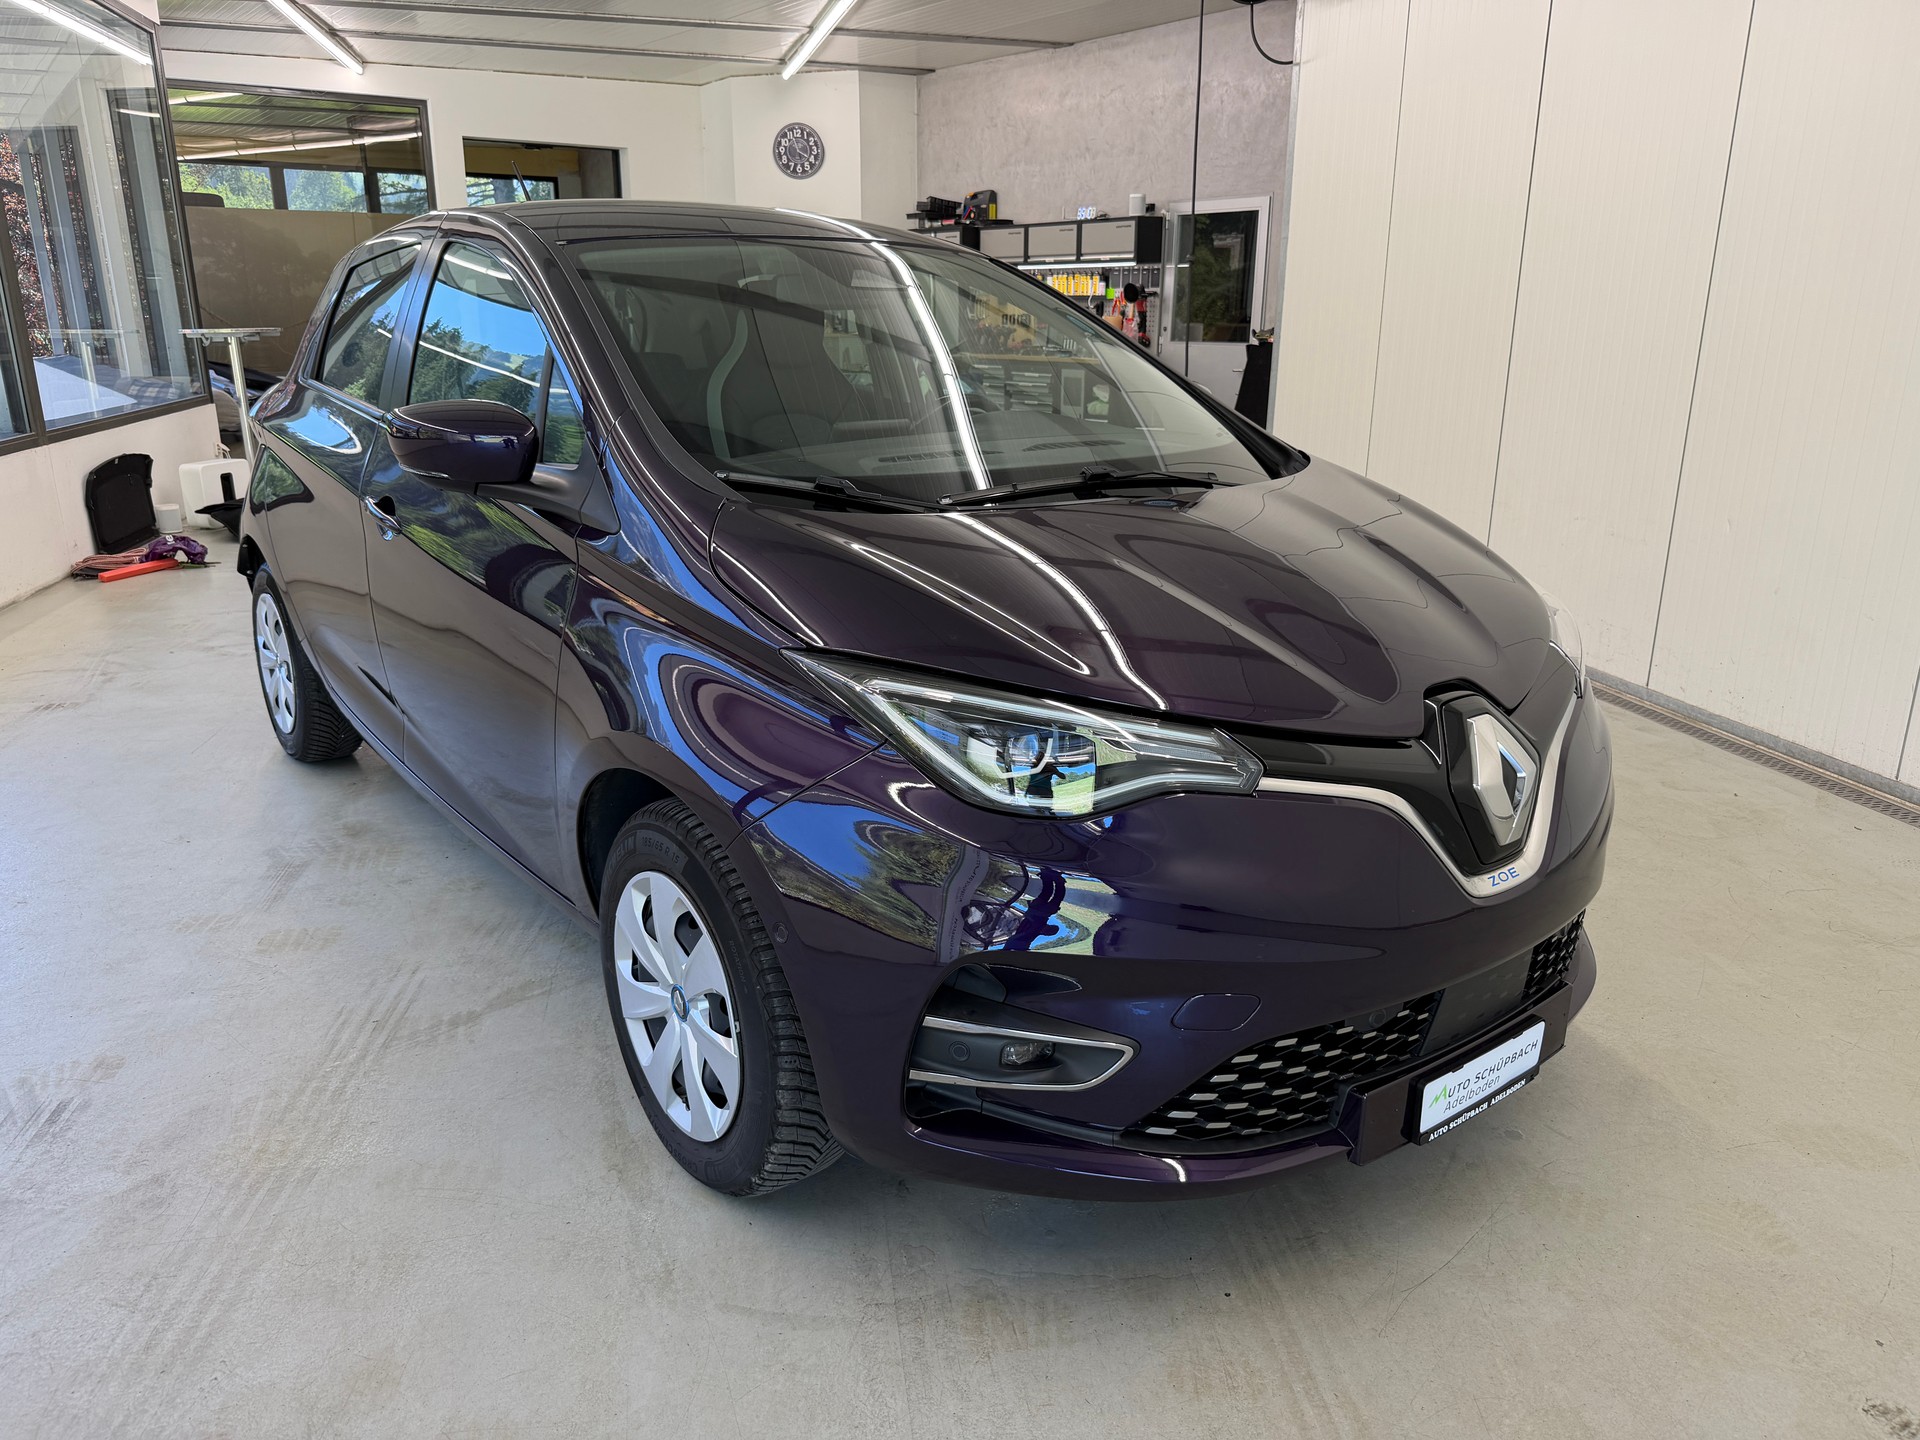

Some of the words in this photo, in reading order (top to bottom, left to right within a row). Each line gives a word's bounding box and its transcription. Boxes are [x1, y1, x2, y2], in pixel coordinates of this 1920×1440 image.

[781, 138, 789, 146] 10
[793, 129, 802, 137] 12
[779, 146, 785, 155] 9
[641, 836, 664, 851] 185/65
[664, 846, 670, 856] R
[671, 852, 680, 864] 15
[1487, 866, 1520, 887] ZOE
[728, 940, 747, 983] ROTATION
[1429, 1079, 1471, 1108] AUTO
[1473, 1040, 1539, 1084] SCHÜPBACH
[1443, 1075, 1500, 1113] Adelboden
[1428, 1125, 1448, 1142] AUTO
[1449, 1101, 1489, 1130] SCHÜPBACH
[1490, 1078, 1526, 1106] ADELBODEN
